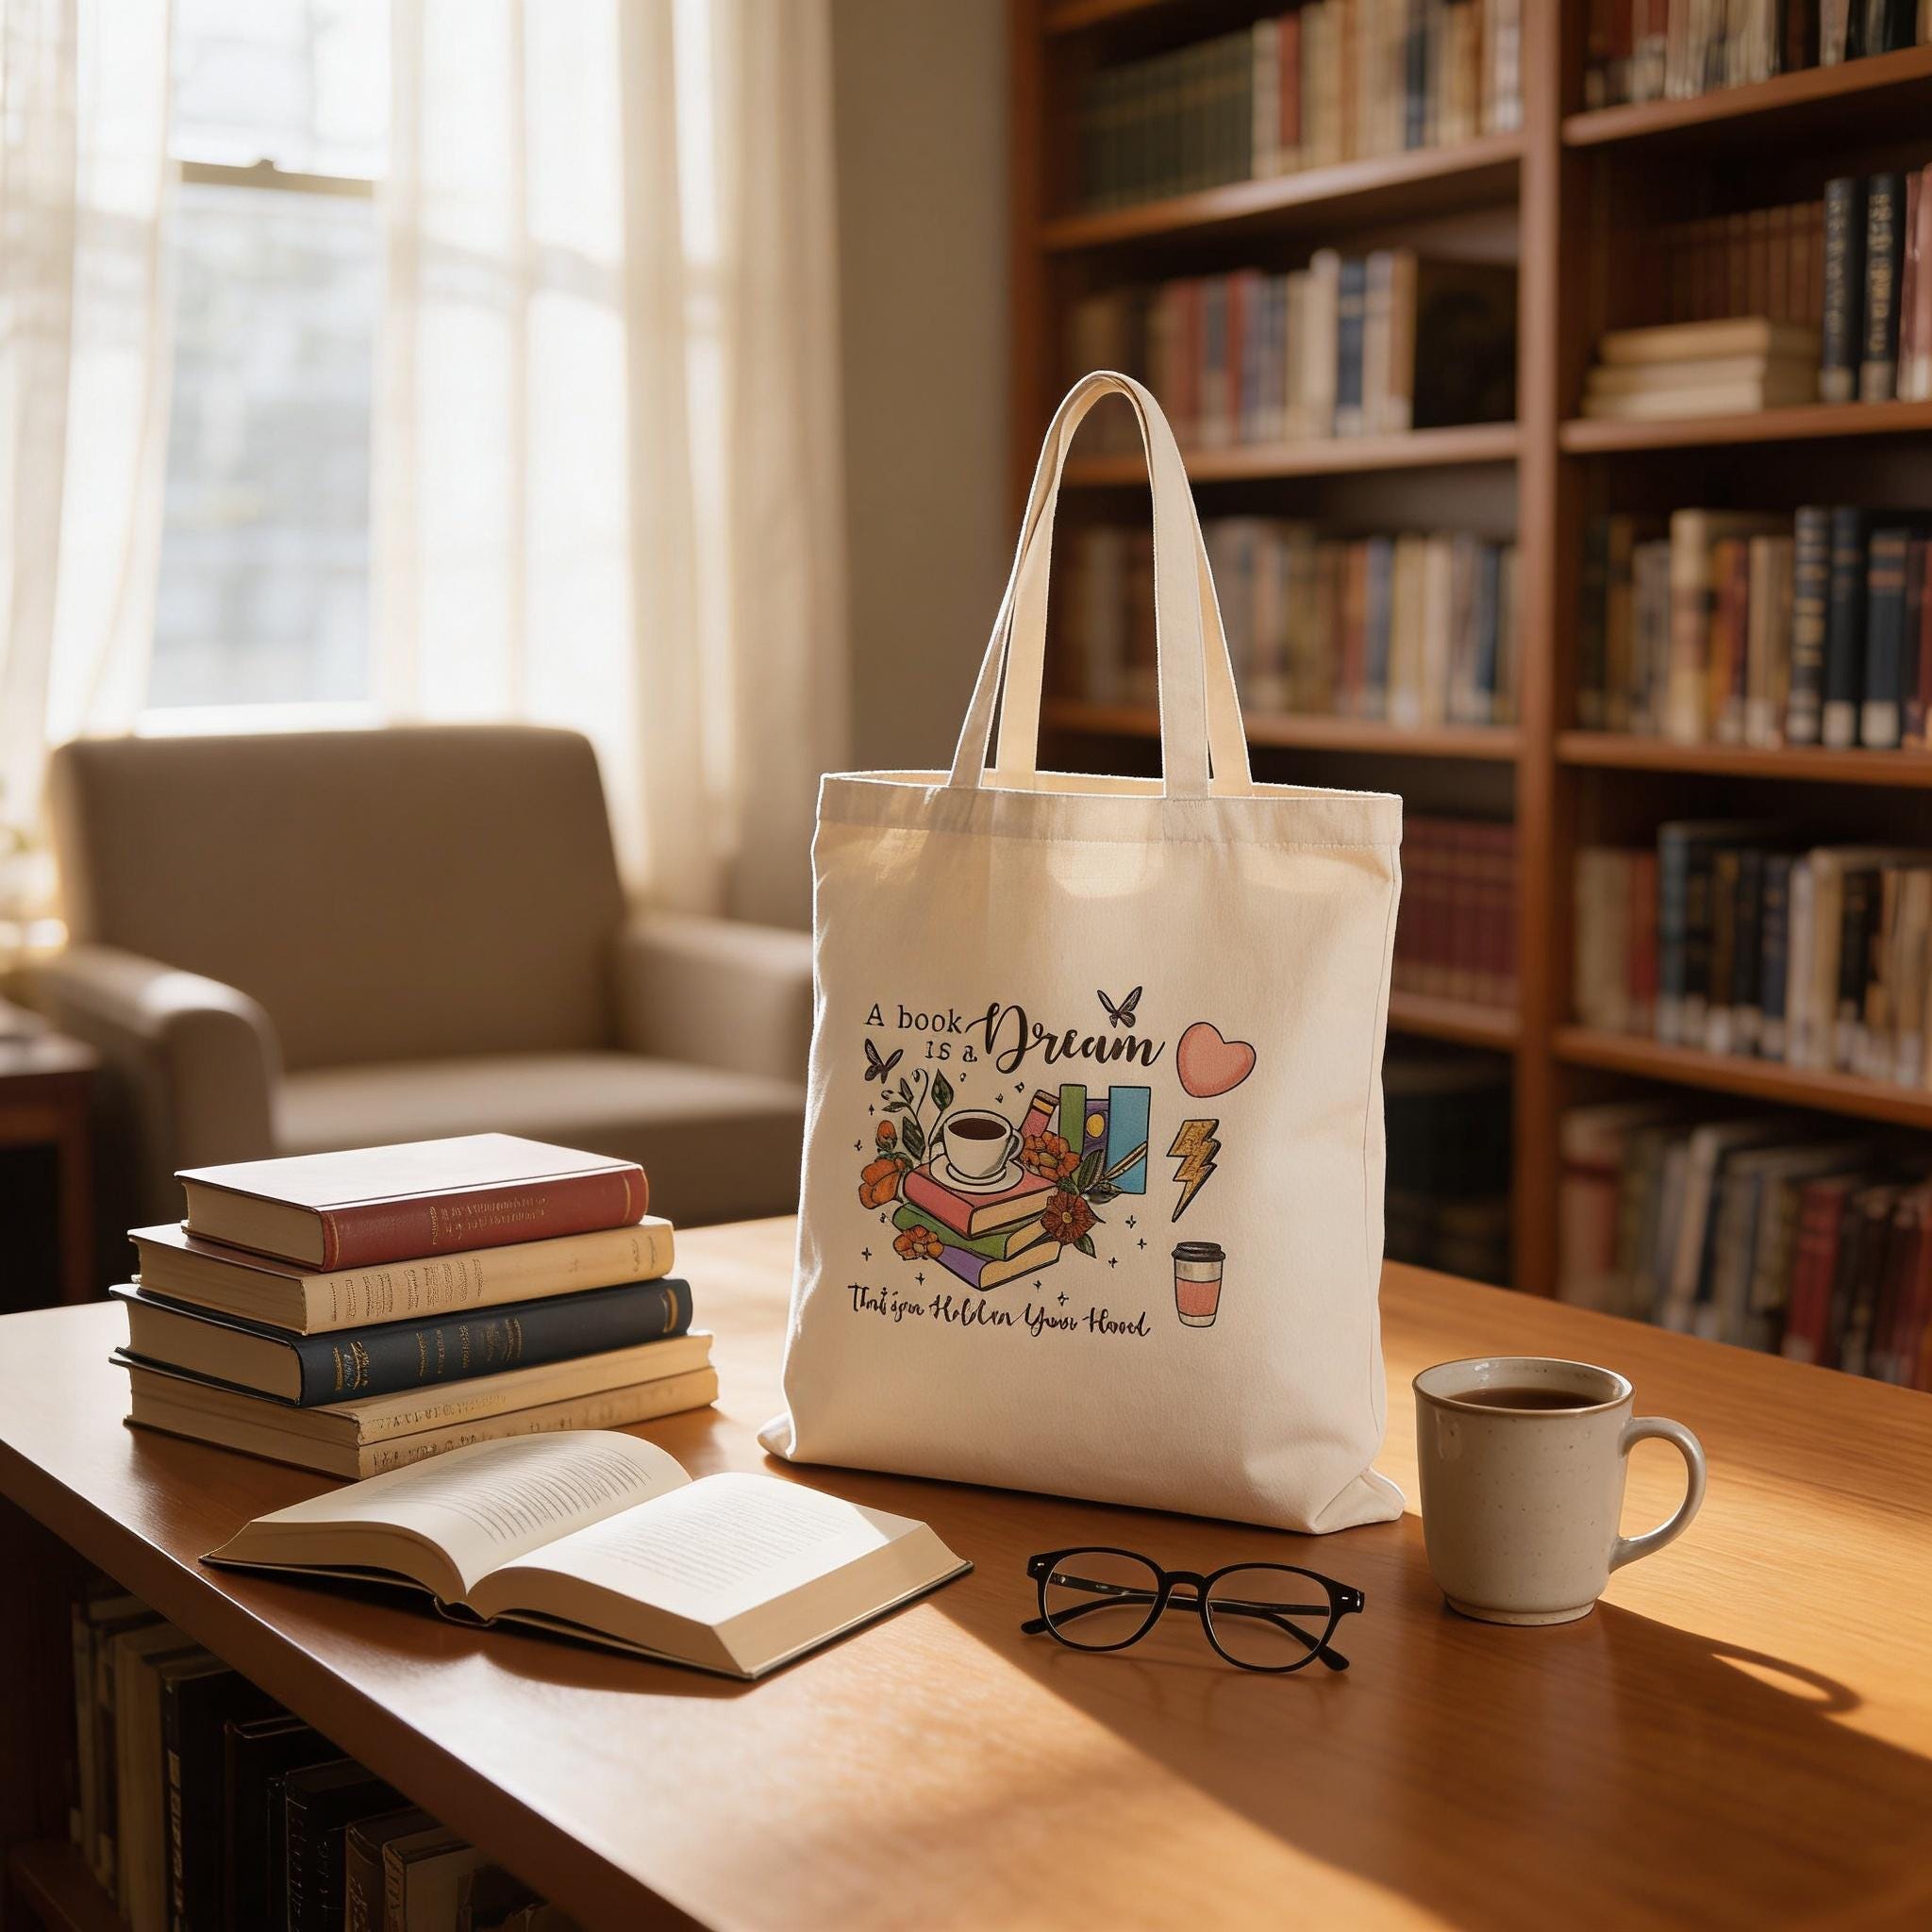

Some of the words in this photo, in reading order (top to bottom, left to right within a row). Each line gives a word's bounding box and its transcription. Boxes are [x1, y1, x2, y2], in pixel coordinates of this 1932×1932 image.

[863, 1003, 885, 1027] A
[897, 1005, 962, 1035] book
[962, 1044, 978, 1063] a
[964, 1002, 1166, 1074] Dream
